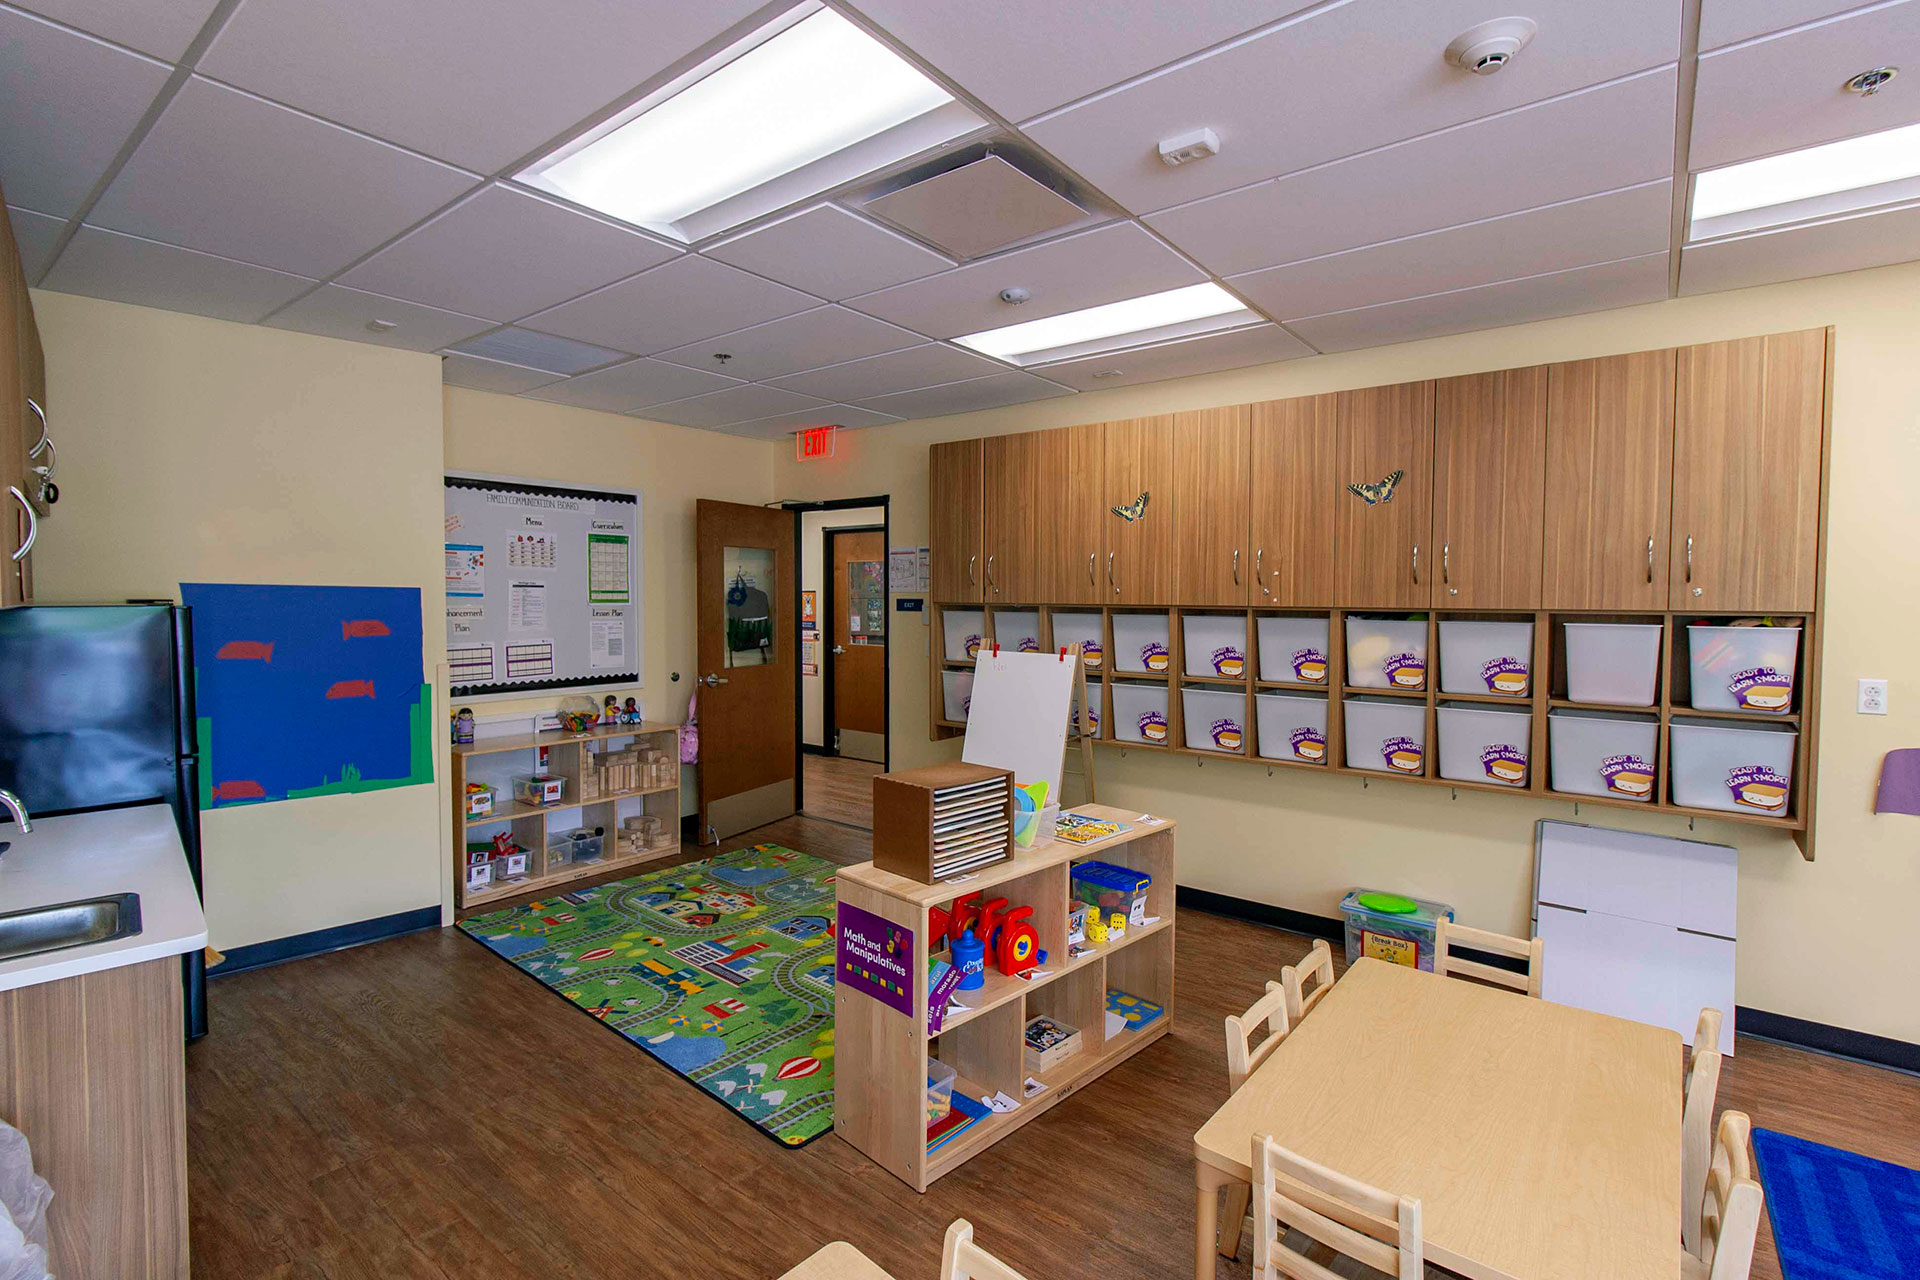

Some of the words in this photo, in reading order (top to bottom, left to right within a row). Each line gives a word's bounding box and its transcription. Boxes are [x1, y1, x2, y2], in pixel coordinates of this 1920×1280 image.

[804, 427, 828, 456] EXIT
[487, 494, 508, 504] FAMILY
[557, 501, 579, 511] BOARD
[525, 517, 542, 526] Menu
[455, 623, 470, 632] Plan
[1732, 668, 1759, 680] READY
[1728, 679, 1754, 692] LEARN
[1604, 755, 1628, 765] READY
[1600, 765, 1622, 776] LEARN
[1731, 766, 1757, 776] READY
[1726, 775, 1751, 787] LEARN
[844, 927, 866, 946] Math
[867, 940, 880, 952] and
[846, 940, 906, 977] Manipulatives
[931, 970, 942, 985] azul
[937, 970, 957, 995] morado
